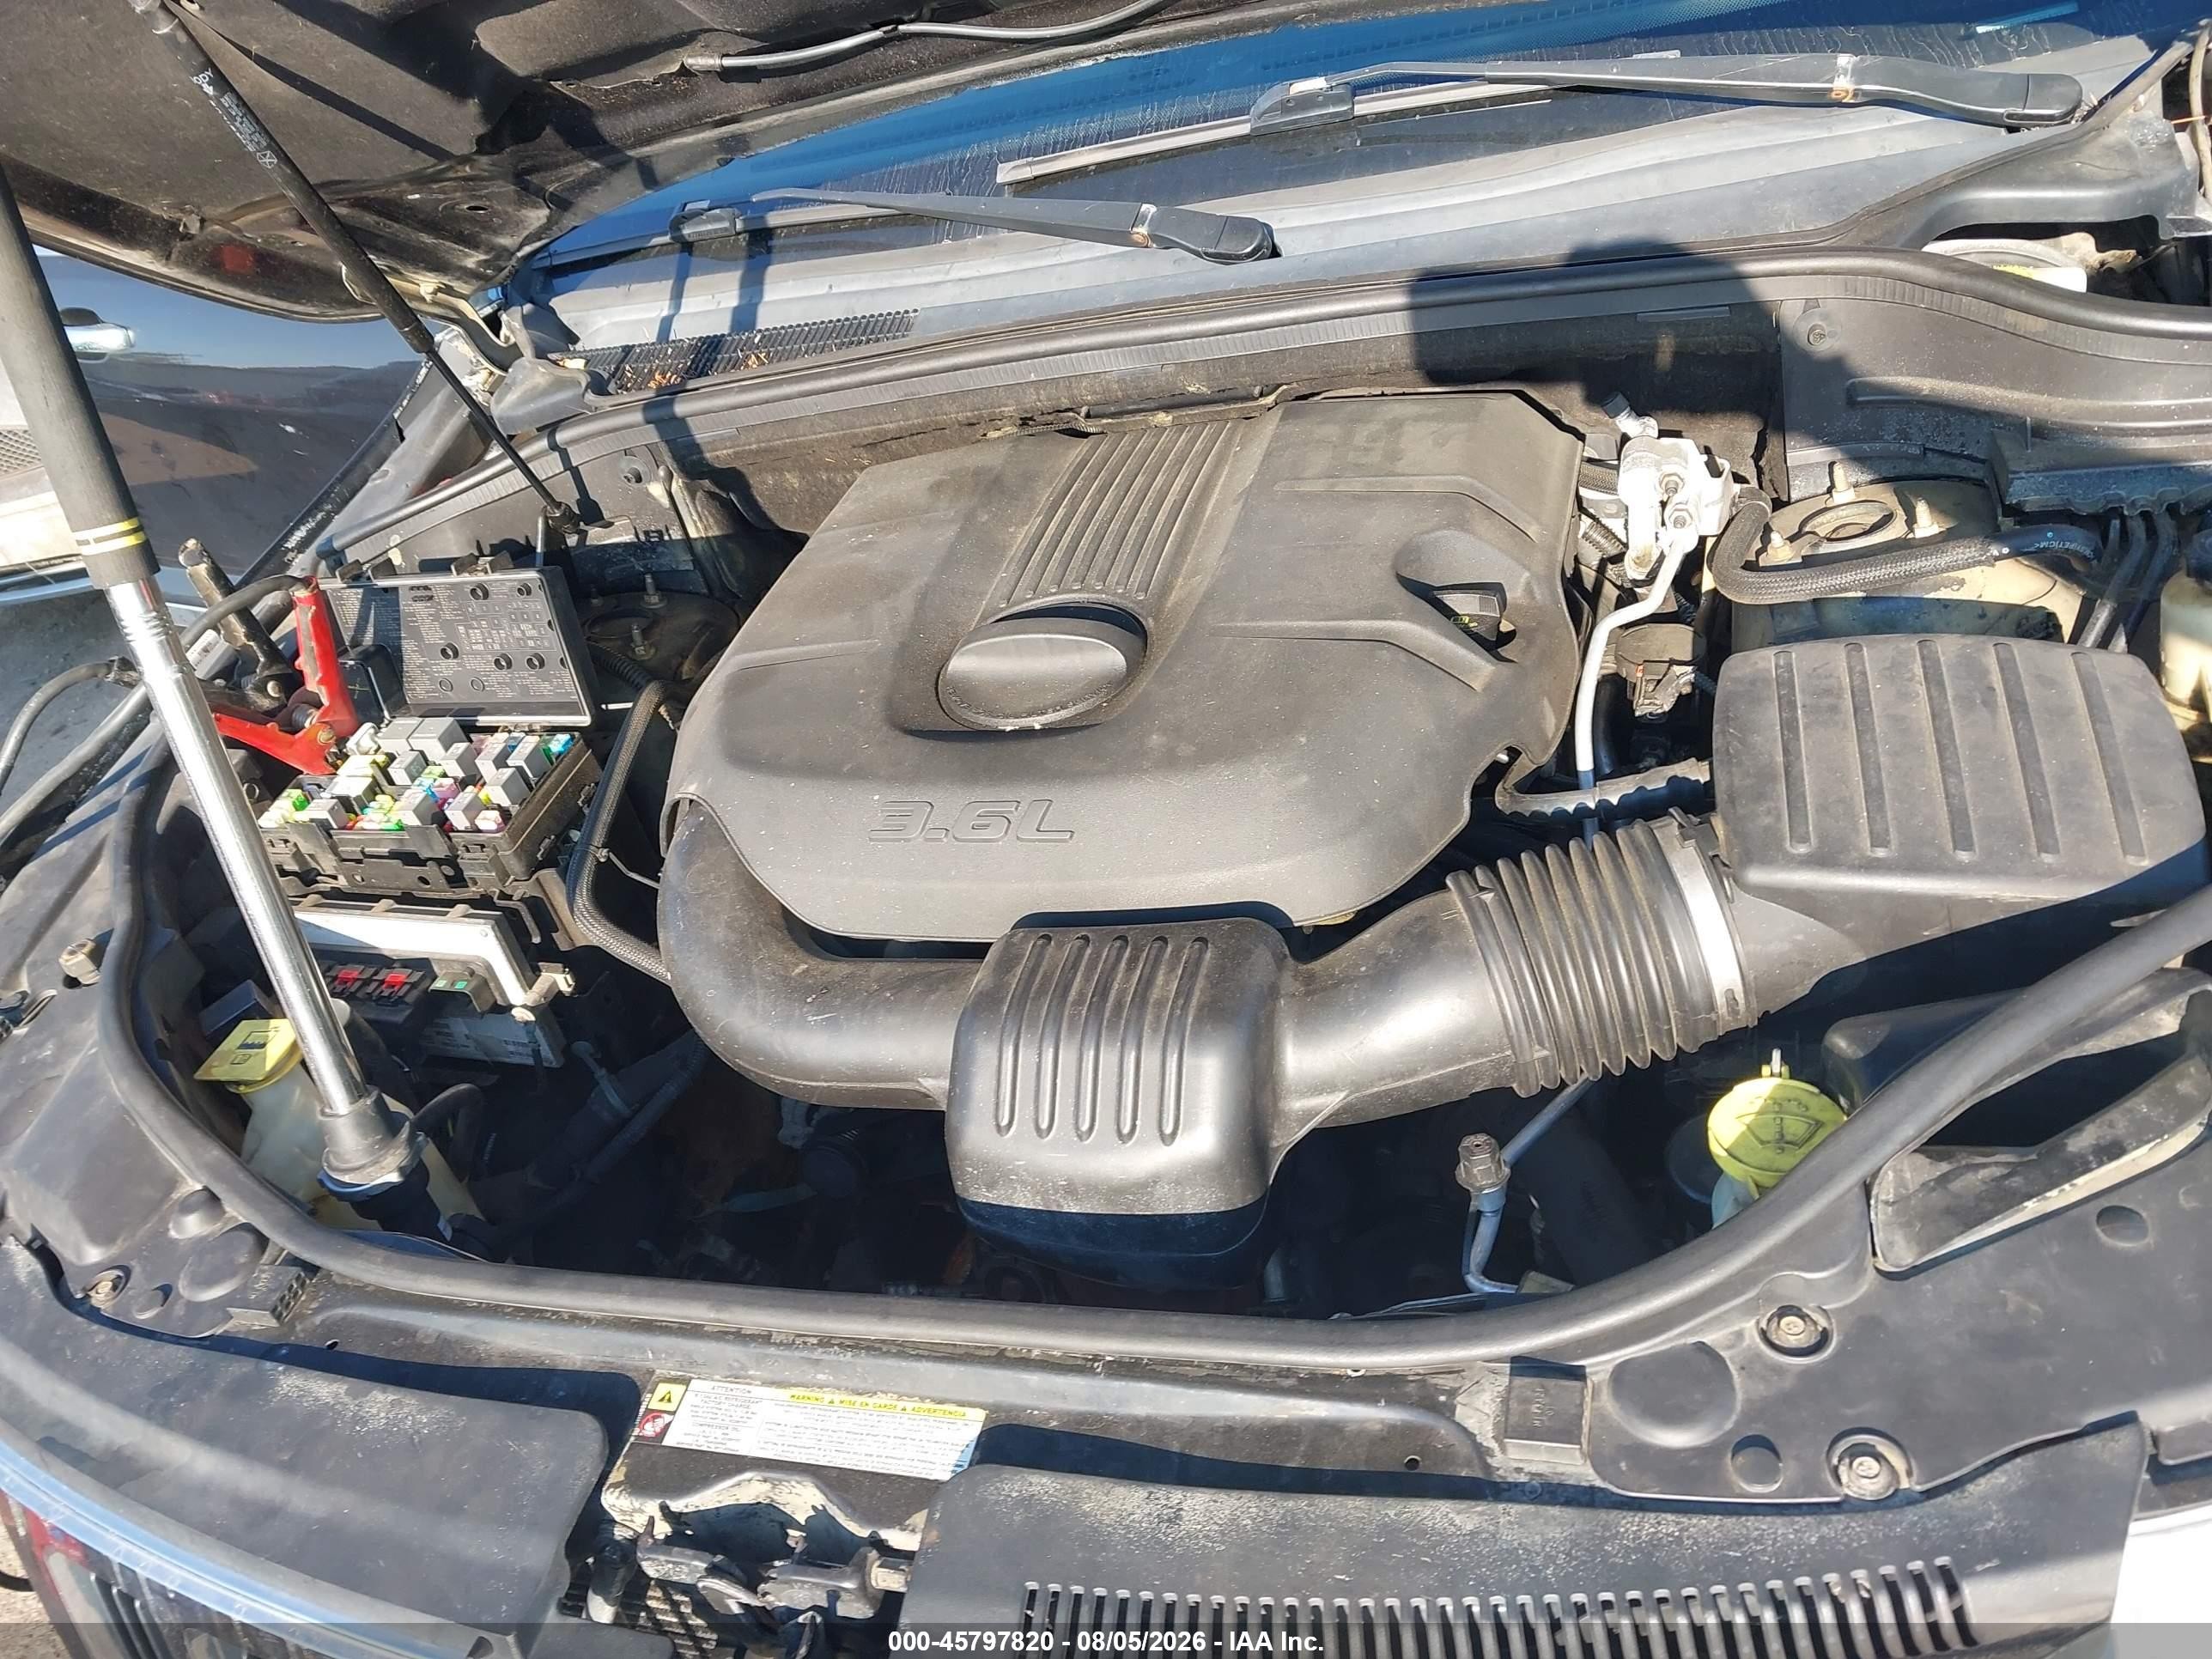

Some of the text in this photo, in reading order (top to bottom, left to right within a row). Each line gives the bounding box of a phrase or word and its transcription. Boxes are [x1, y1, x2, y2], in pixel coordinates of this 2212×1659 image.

[190, 68, 214, 85] ODY
[868, 799, 1075, 843] 3.6L
[711, 1385, 752, 1394] ATTENTION
[789, 1394, 825, 1403] WARNING
[839, 1398, 857, 1407] MISE
[872, 1402, 898, 1411] GARDE
[912, 1406, 968, 1417] ADVERTENCIA
